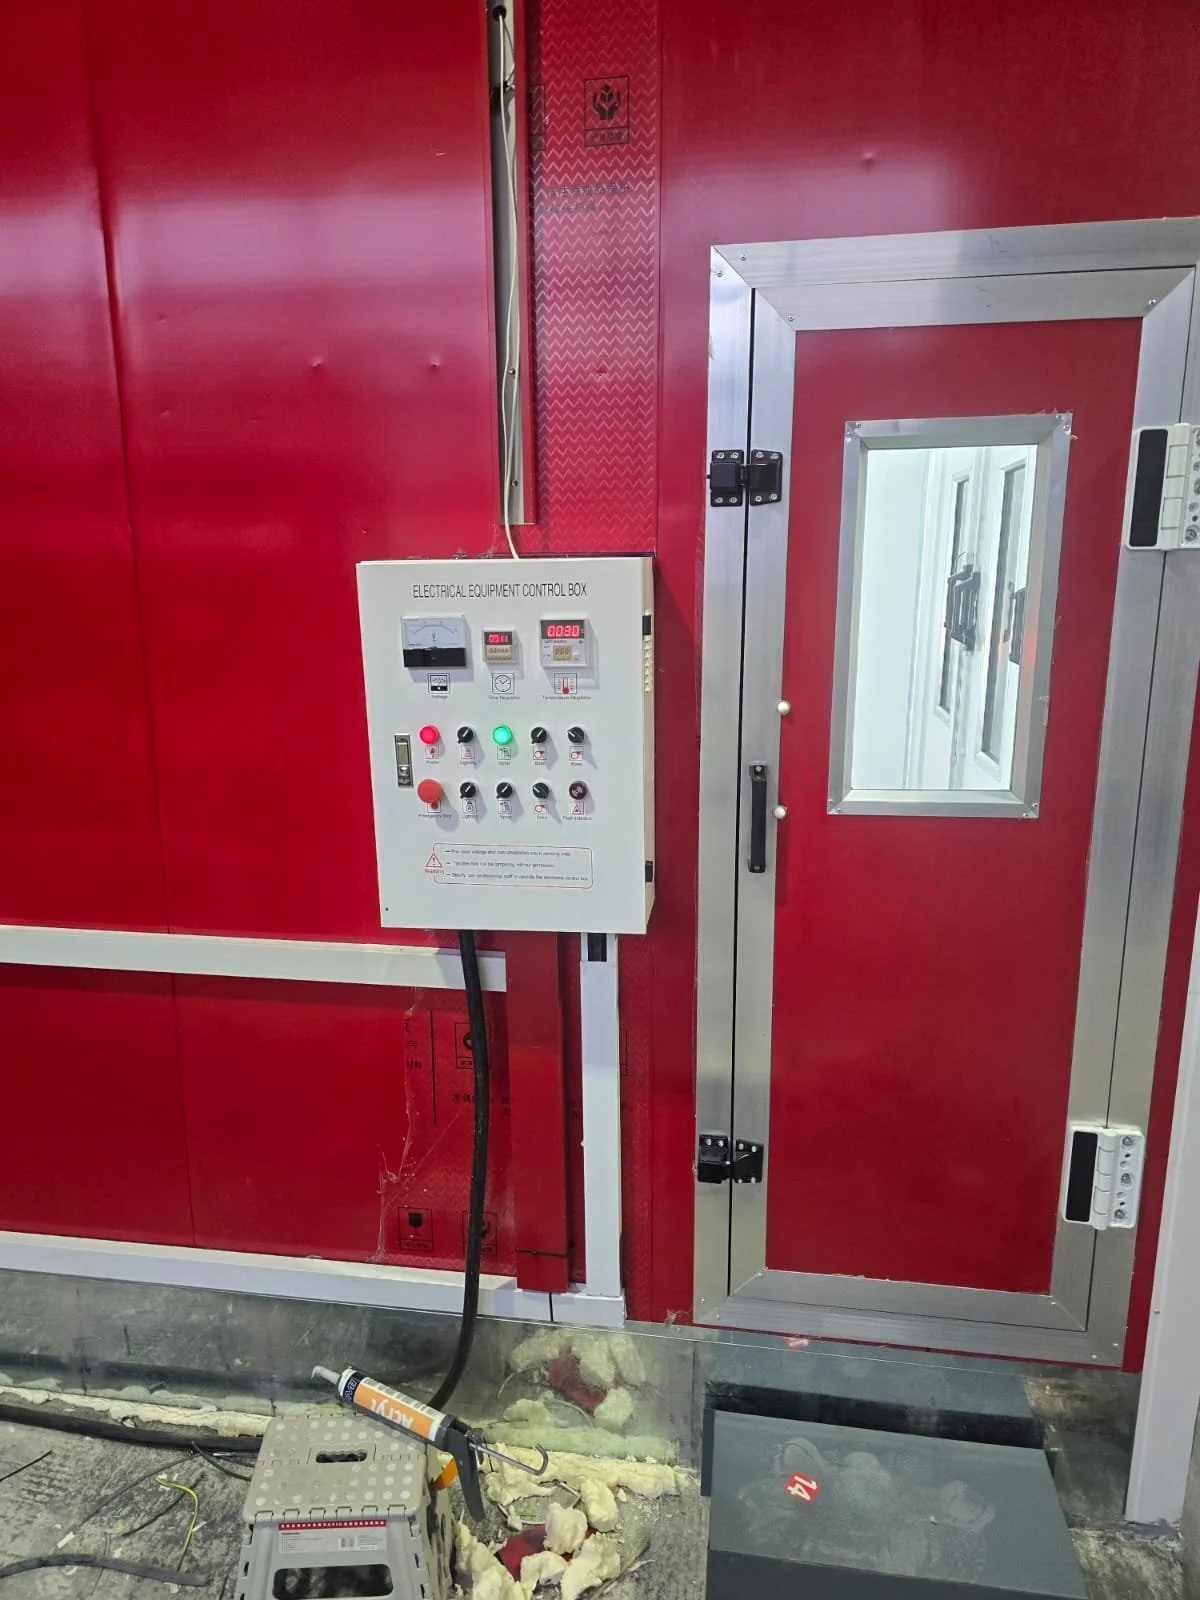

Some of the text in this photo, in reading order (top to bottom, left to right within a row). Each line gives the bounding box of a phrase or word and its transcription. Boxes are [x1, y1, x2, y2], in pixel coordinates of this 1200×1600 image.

[413, 582, 588, 598] ELECTRICAL EQUIPMENT CONTROL BOX
[547, 625, 580, 637] 0030
[787, 1475, 818, 1501] 14
